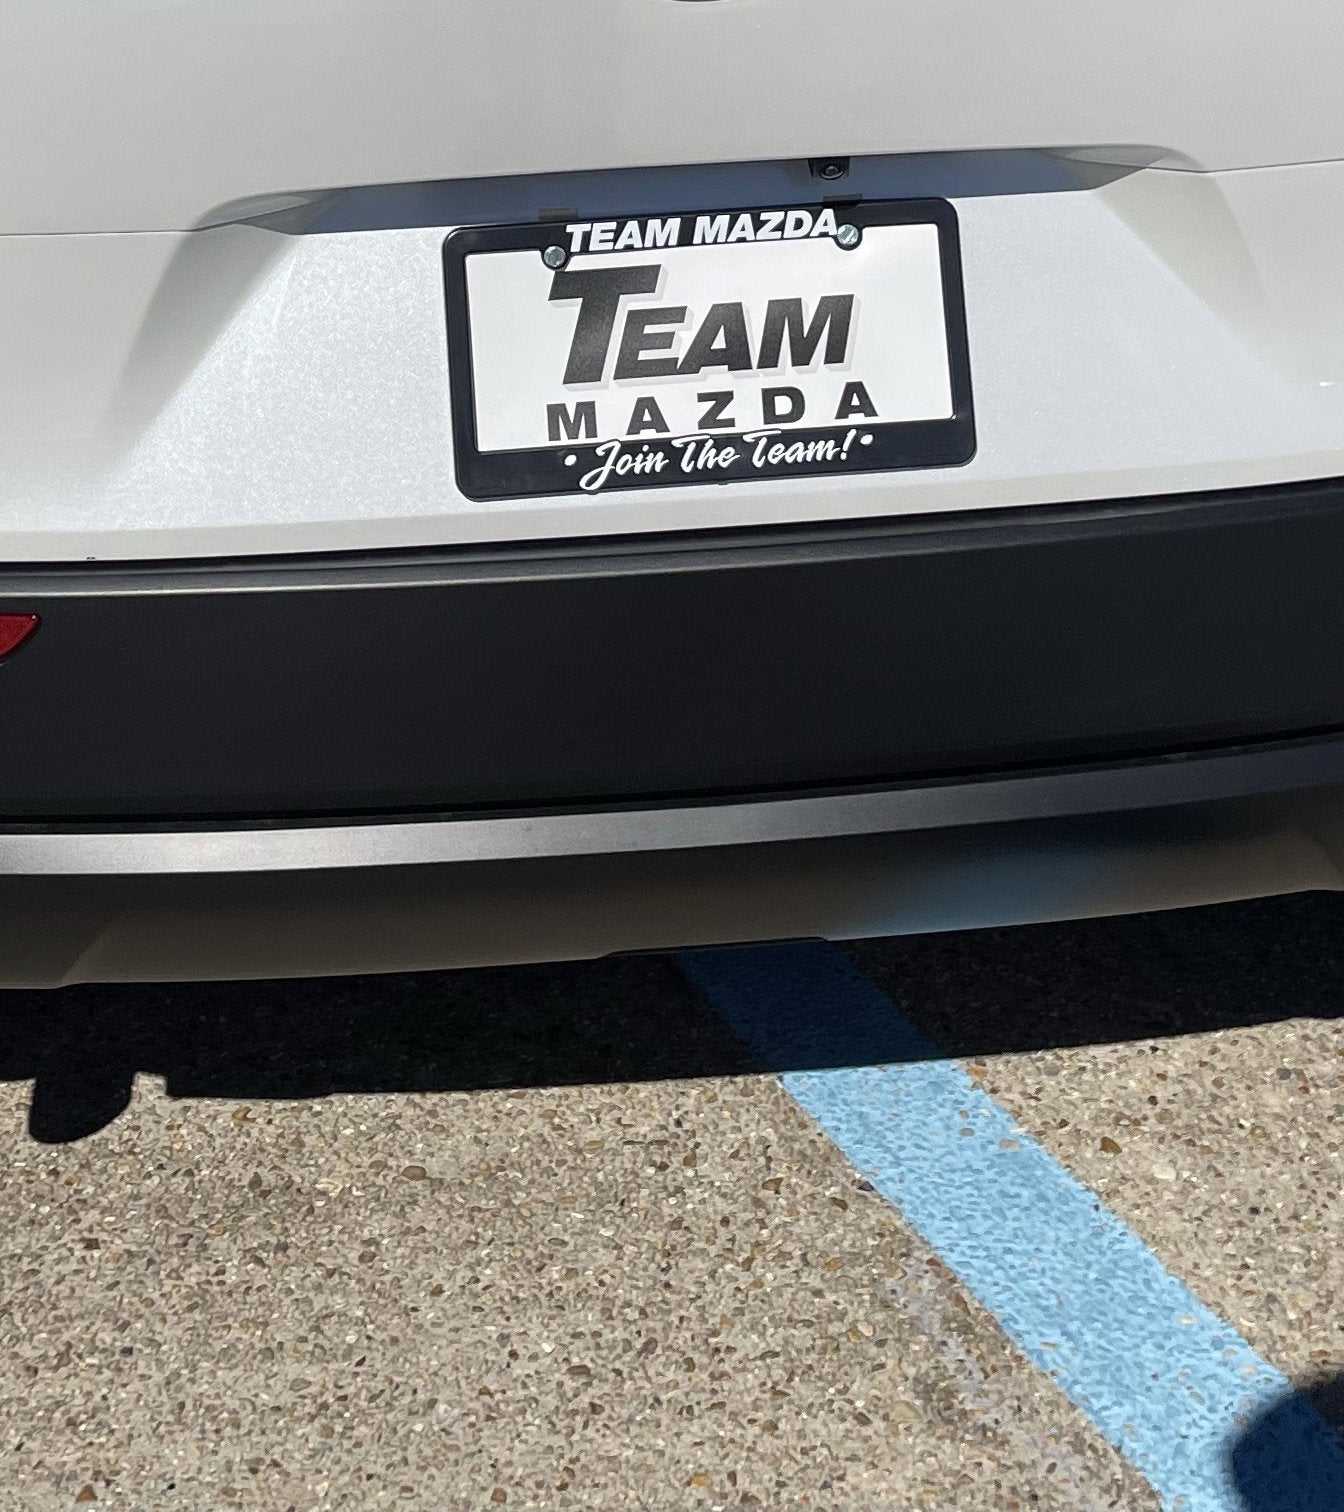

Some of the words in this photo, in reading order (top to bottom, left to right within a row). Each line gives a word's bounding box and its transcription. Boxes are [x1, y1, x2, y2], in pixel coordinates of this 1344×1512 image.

[566, 217, 679, 253] TEAM
[694, 208, 837, 244] MAZDA
[546, 381, 878, 441] MAZDA
[579, 440, 668, 491] Join
[672, 431, 741, 473] The
[743, 427, 854, 466] Team!
